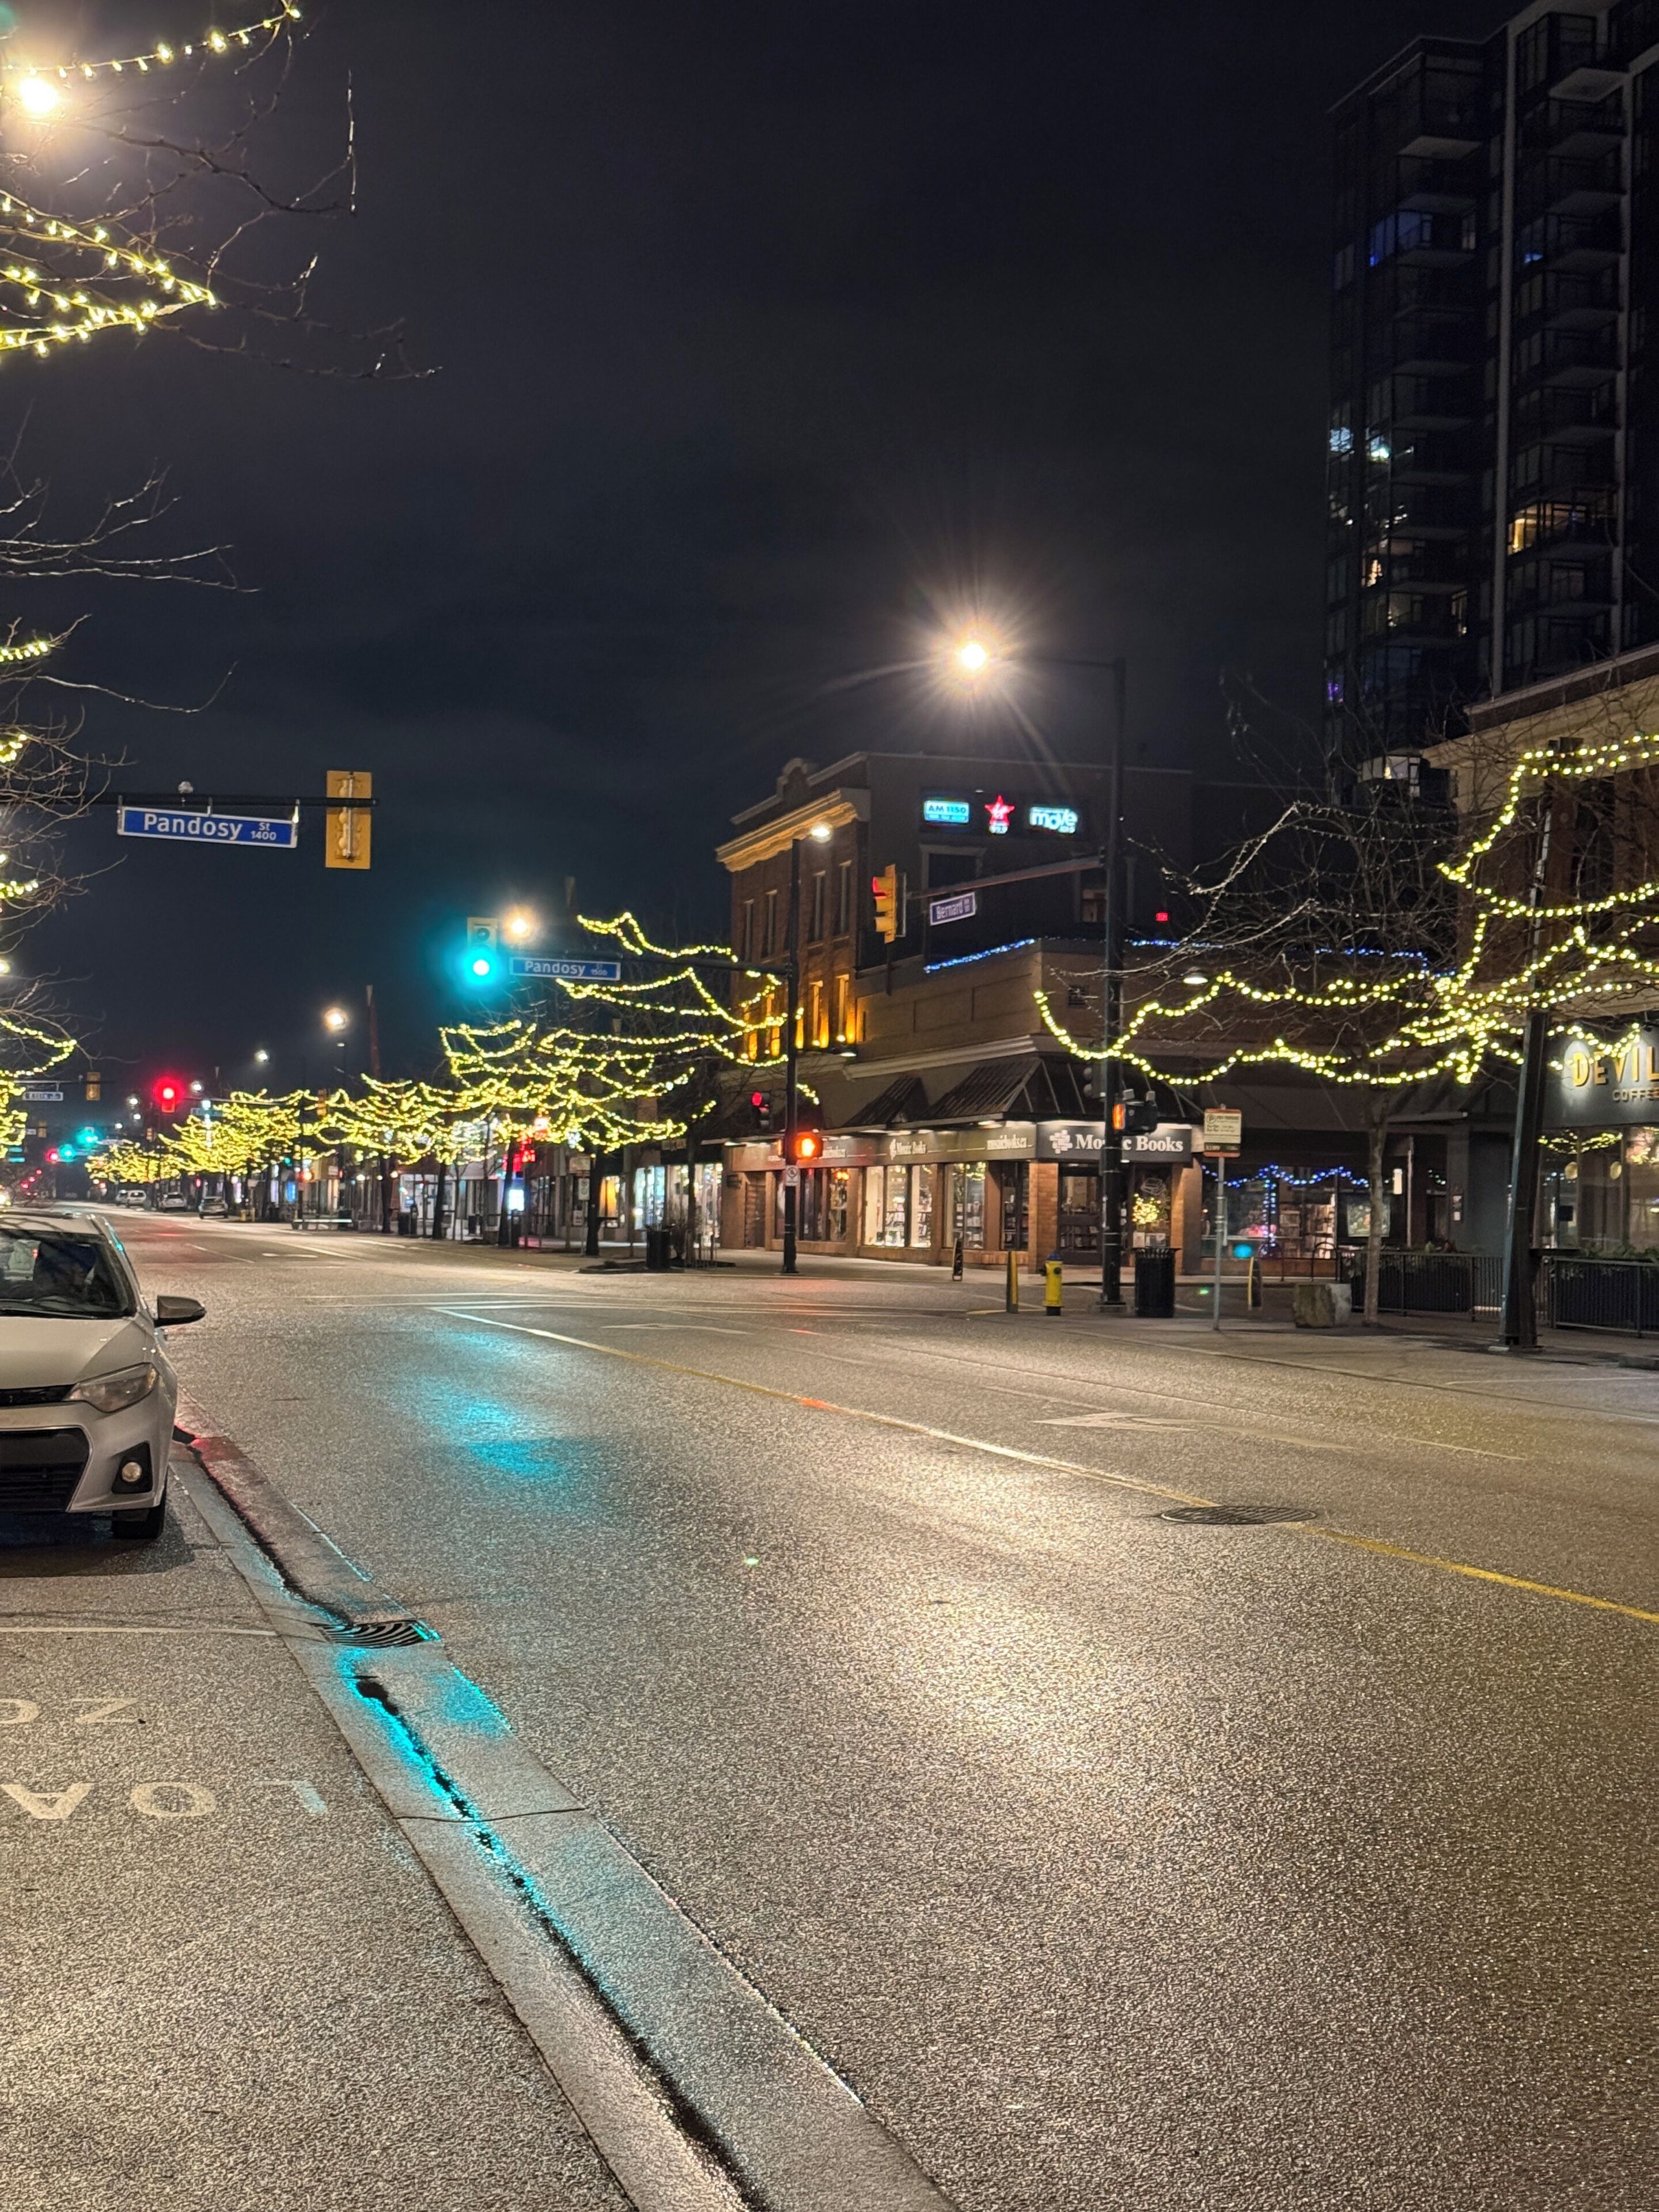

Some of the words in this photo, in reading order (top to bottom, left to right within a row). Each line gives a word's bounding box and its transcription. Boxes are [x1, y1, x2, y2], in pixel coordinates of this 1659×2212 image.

[144, 813, 243, 840] Pandosy
[1030, 808, 1078, 830] move
[251, 831, 276, 840] 1400
[937, 900, 963, 920] Bernard
[525, 961, 586, 976] Pandosy
[1135, 1135, 1183, 1152] Books
